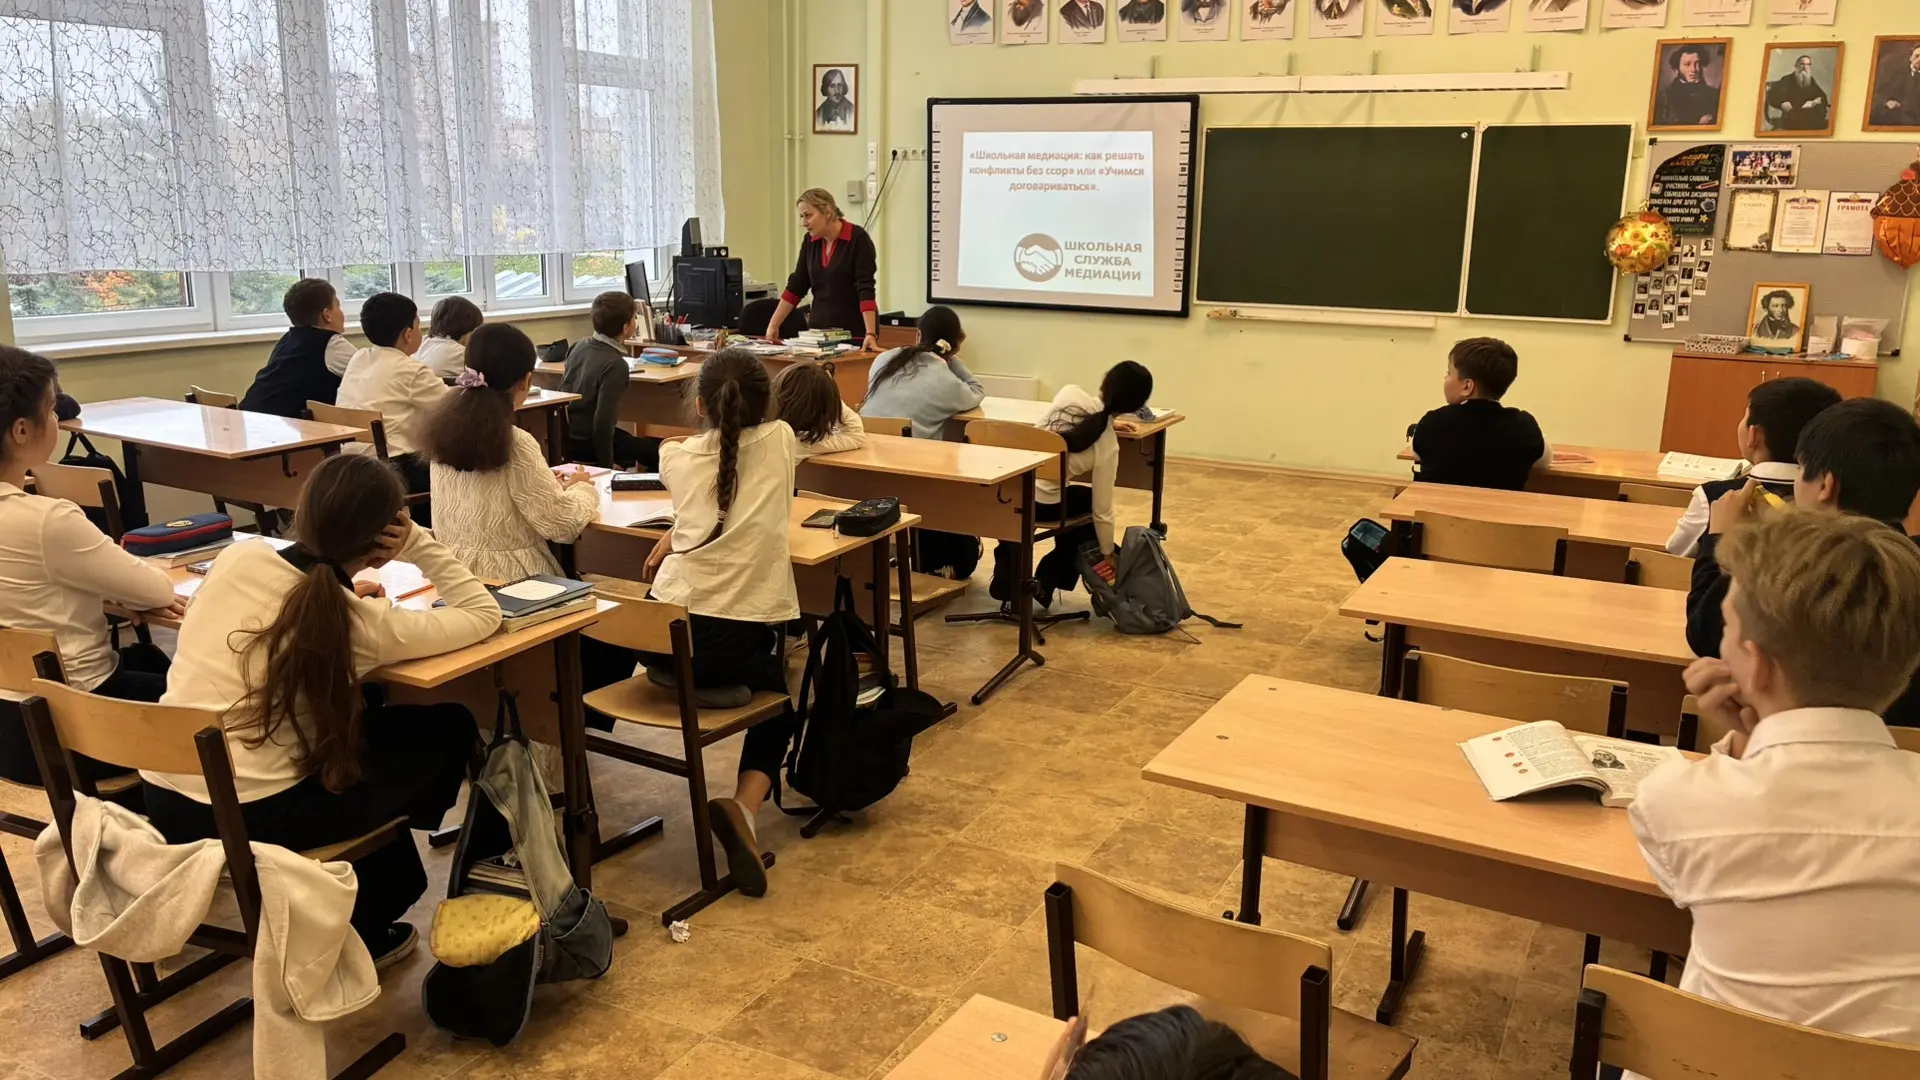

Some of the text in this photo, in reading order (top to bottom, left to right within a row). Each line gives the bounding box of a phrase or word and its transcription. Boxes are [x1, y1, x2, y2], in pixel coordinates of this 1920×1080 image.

[970, 151, 1144, 162] «Школьная медиация: как решать
[969, 165, 1024, 176] конфликты
[1026, 166, 1043, 176] без
[1046, 168, 1074, 177] ссор»
[1098, 166, 1144, 176] «Учимся
[1009, 182, 1099, 192] договариваться».
[1064, 241, 1142, 252] ШКОЛЬНАЯ
[1074, 255, 1132, 266] СЛУЖБА
[1064, 268, 1141, 281] МЕДИАЦИИ
